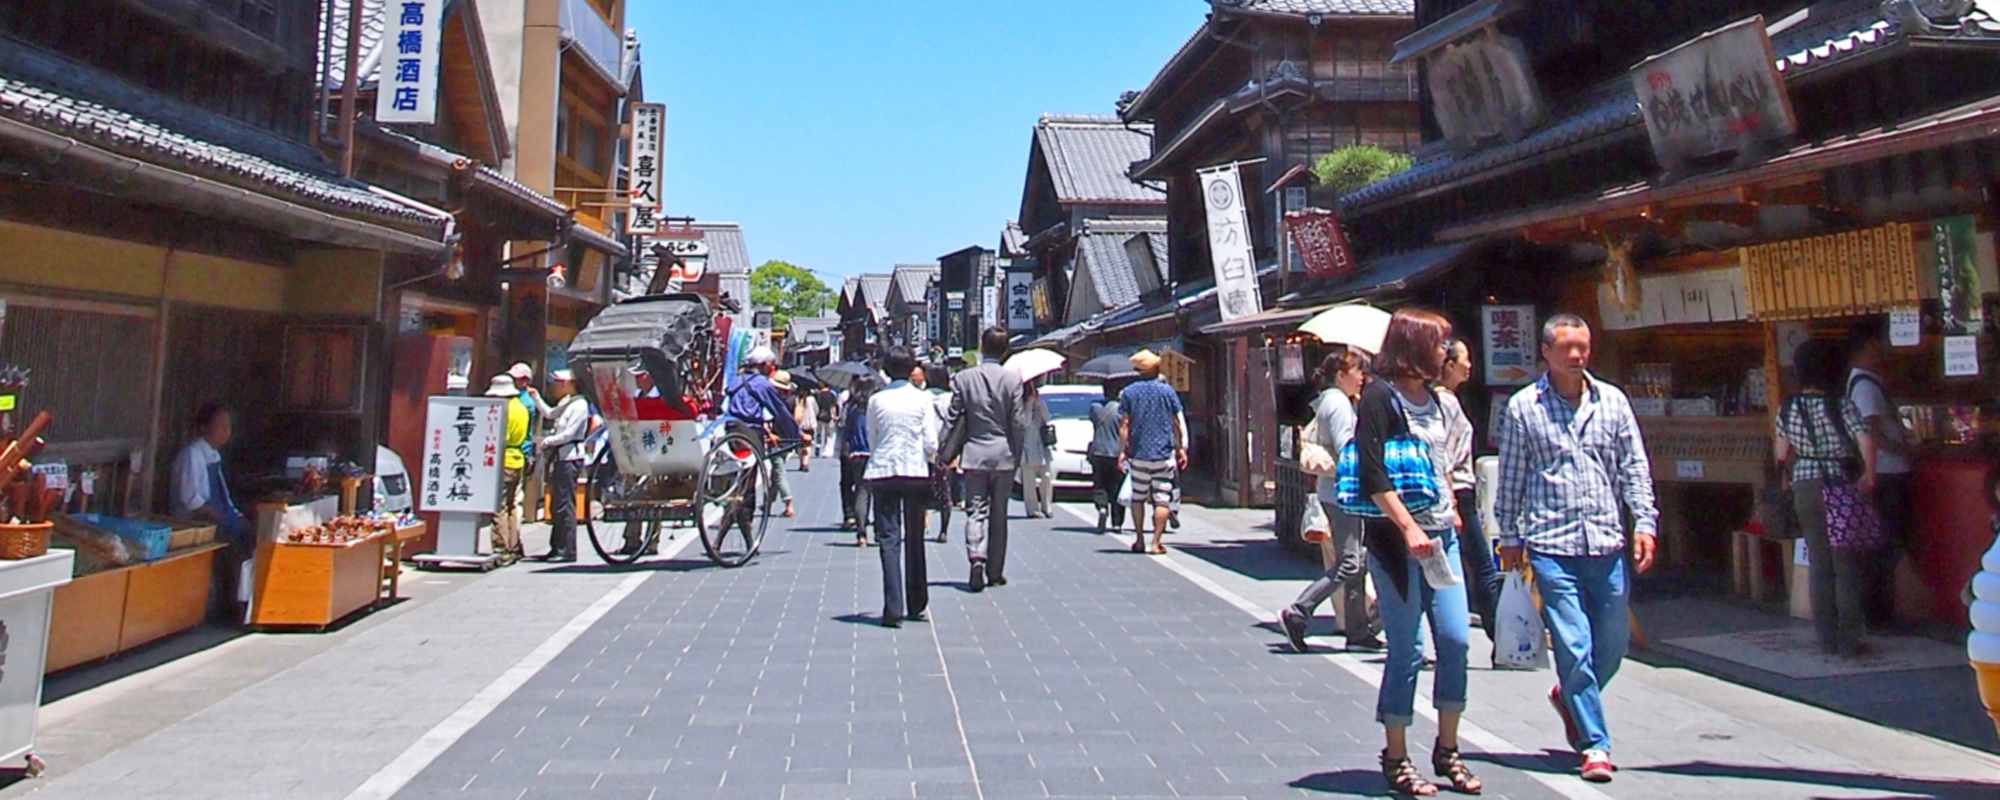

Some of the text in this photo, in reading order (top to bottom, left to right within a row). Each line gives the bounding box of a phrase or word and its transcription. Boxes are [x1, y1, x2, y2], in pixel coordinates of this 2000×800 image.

[632, 154, 656, 229] 喜久屋
[1491, 311, 1520, 349] 喫茶
[446, 406, 477, 501] 三重の寒梅
